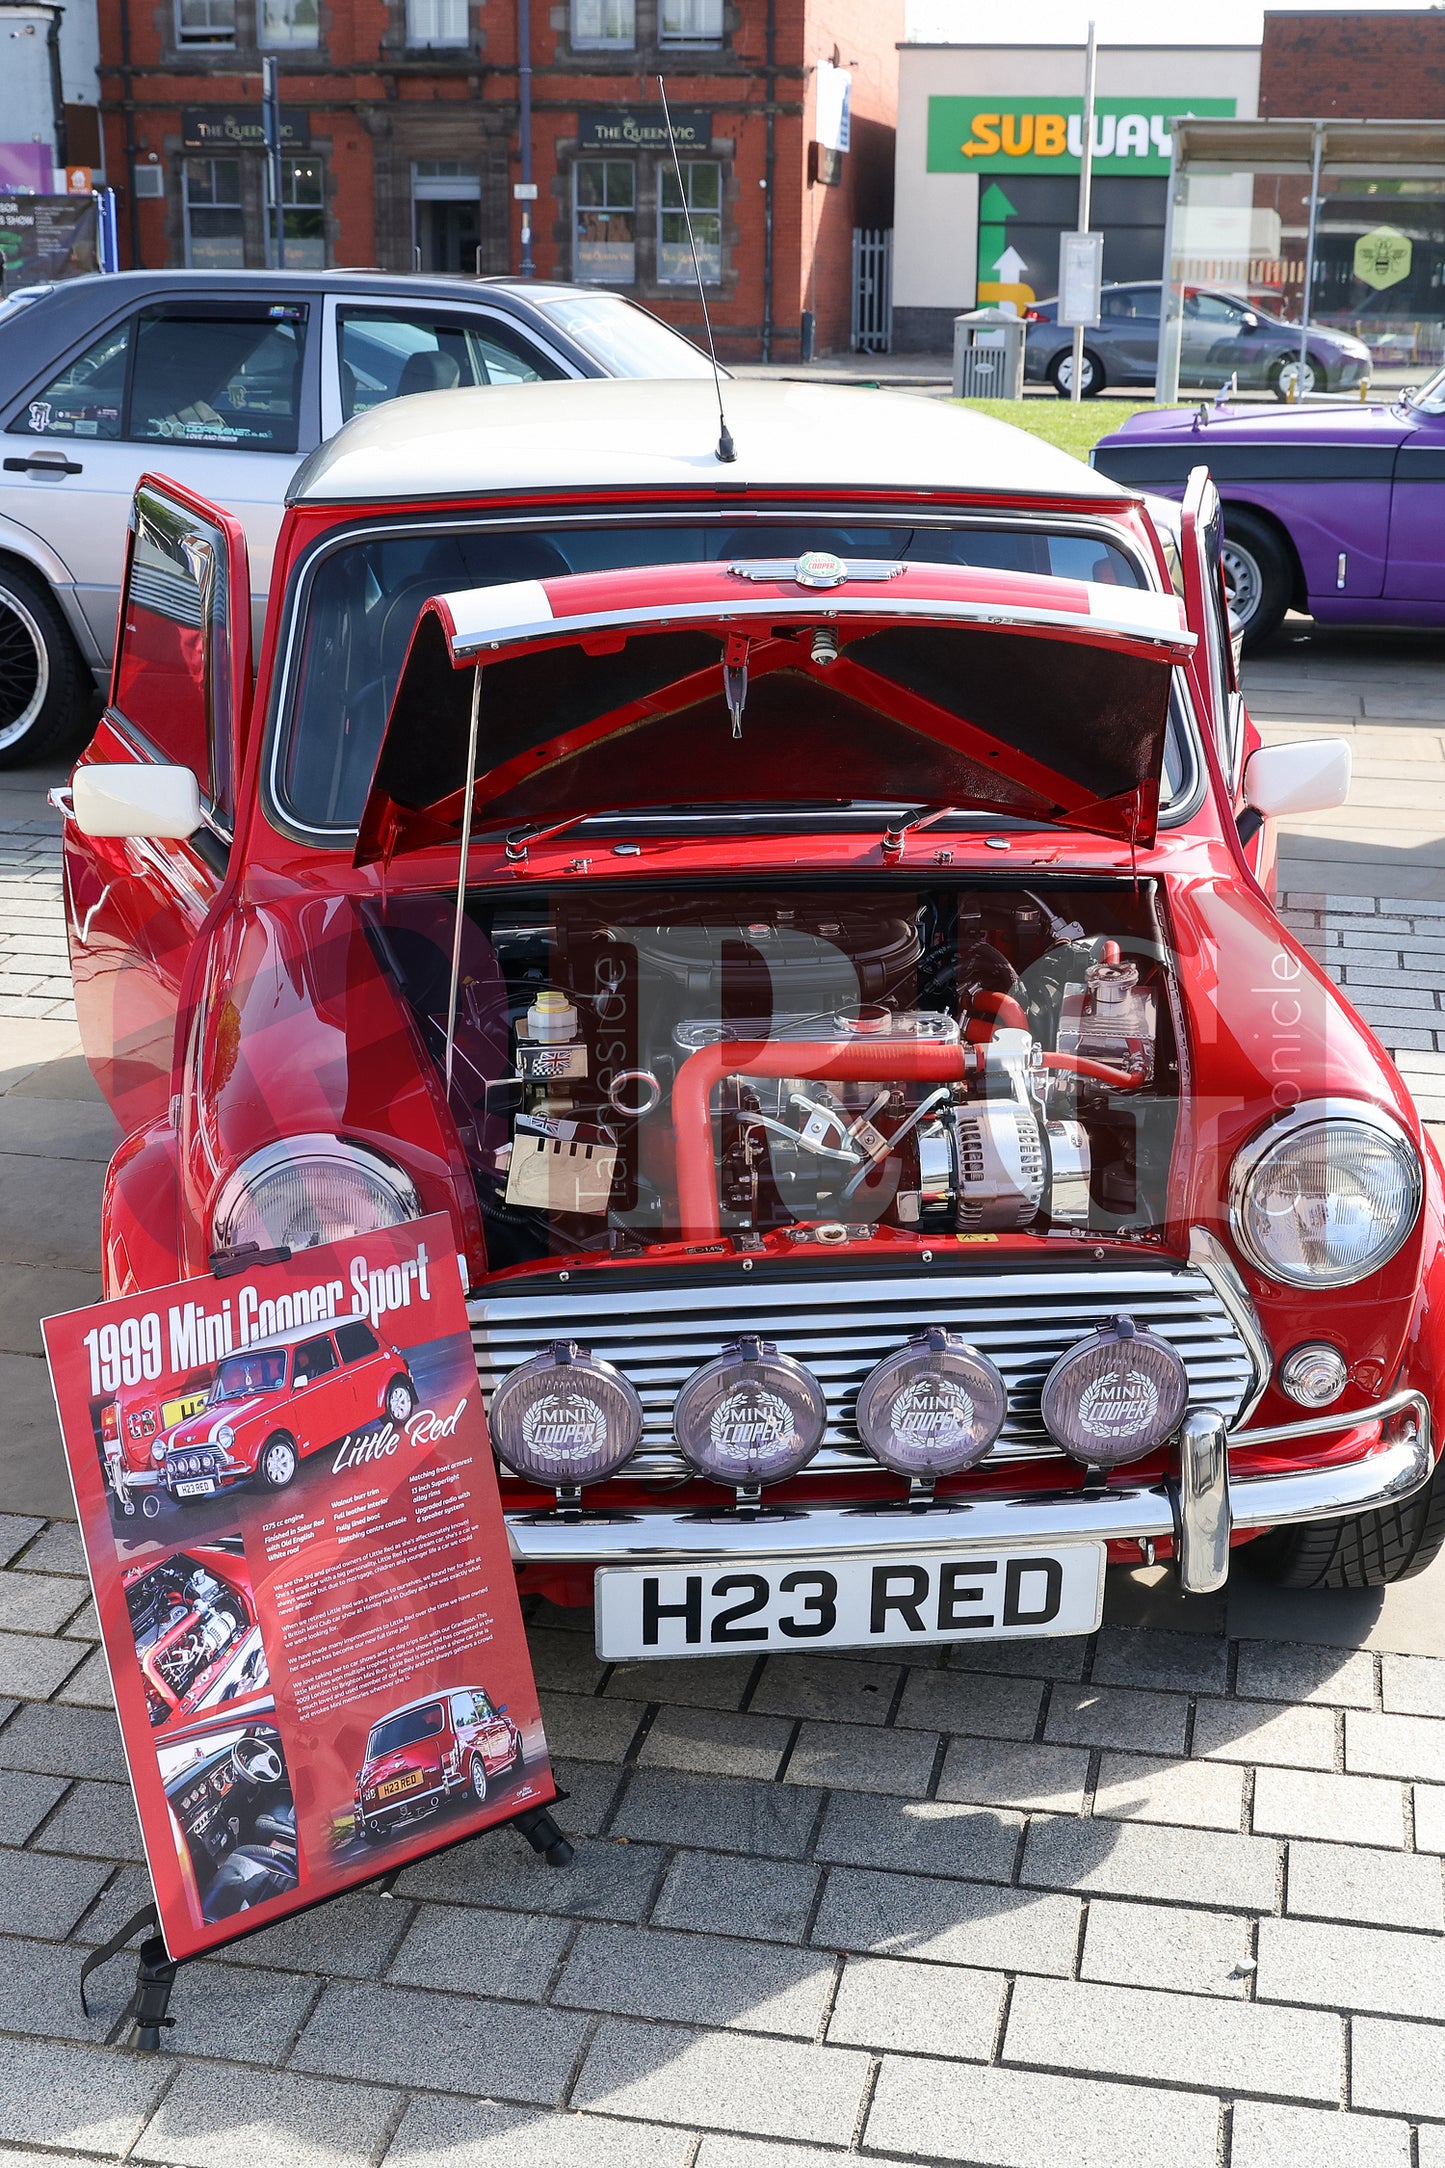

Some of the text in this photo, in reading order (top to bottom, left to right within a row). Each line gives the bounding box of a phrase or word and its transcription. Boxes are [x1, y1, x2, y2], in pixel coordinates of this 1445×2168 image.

[594, 125, 695, 142] THE QUEEN VIC
[960, 113, 1174, 159] SUBWAY
[808, 562, 836, 570] COOPER
[83, 1313, 162, 1396] 1999
[168, 1298, 233, 1374] Mini
[350, 1243, 431, 1329] Sport
[913, 1396, 955, 1410] MINI
[1101, 1386, 1142, 1400] MINI
[542, 1408, 586, 1423] MINI
[731, 1407, 774, 1422] MINI
[901, 1411, 962, 1431] COOPER
[1088, 1400, 1149, 1421] COOPER
[331, 1398, 467, 1474] Little Red
[534, 1423, 596, 1443] COOPER
[721, 1420, 783, 1443] COOPER
[409, 1457, 473, 1483] Matching front armrest
[418, 1483, 430, 1492] inch
[431, 1474, 460, 1488] Superlight
[331, 1488, 380, 1508] Walnut burr trim
[413, 1490, 441, 1503] alloy rims
[415, 1491, 470, 1515] Upgraded radio with
[334, 1498, 389, 1520] Full leather interior
[422, 1510, 444, 1522] speaker
[444, 1503, 464, 1514] system
[262, 1522, 276, 1532] 1275
[284, 1514, 304, 1524] engine
[264, 1530, 289, 1544] Finished
[297, 1523, 313, 1533] Solar
[313, 1518, 325, 1527] Red
[336, 1513, 380, 1533] Fully lined boot
[338, 1516, 407, 1544] Matching centre console
[266, 1531, 314, 1552] with Old English
[268, 1545, 300, 1561] White roof
[304, 1573, 314, 1581] 3rd
[314, 1569, 325, 1578] and
[325, 1563, 342, 1574] proud
[342, 1557, 362, 1568] owners
[362, 1553, 368, 1561] of
[368, 1550, 383, 1558] Little
[383, 1545, 394, 1553] Red
[415, 1526, 450, 1542] affectionately
[277, 1597, 296, 1608] always
[296, 1589, 317, 1601] wanted
[317, 1586, 328, 1594] but
[328, 1582, 338, 1590] due
[374, 1562, 396, 1574] children
[396, 1557, 406, 1566] and
[406, 1550, 428, 1563] younger
[458, 1534, 473, 1544] could
[295, 1582, 310, 1593] small
[310, 1580, 319, 1588] car
[319, 1576, 332, 1584] with
[377, 1555, 392, 1564] Little
[392, 1550, 403, 1558] Red
[418, 1540, 435, 1550] dream
[278, 1606, 294, 1616] never
[642, 1558, 1063, 1645] H23 RED
[294, 1636, 308, 1645] were
[308, 1629, 329, 1640] looking
[300, 1660, 311, 1669] and
[311, 1657, 321, 1665] she
[321, 1653, 332, 1661] has
[332, 1645, 354, 1657] become
[376, 1632, 386, 1640] full
[386, 1628, 398, 1637] time
[299, 1712, 310, 1721] and
[310, 1706, 330, 1717] evokes
[330, 1700, 342, 1709] Mini
[342, 1690, 370, 1704] memories
[369, 1681, 394, 1694] wherever
[394, 1677, 404, 1685] she
[383, 1774, 417, 1796] H23 RED
